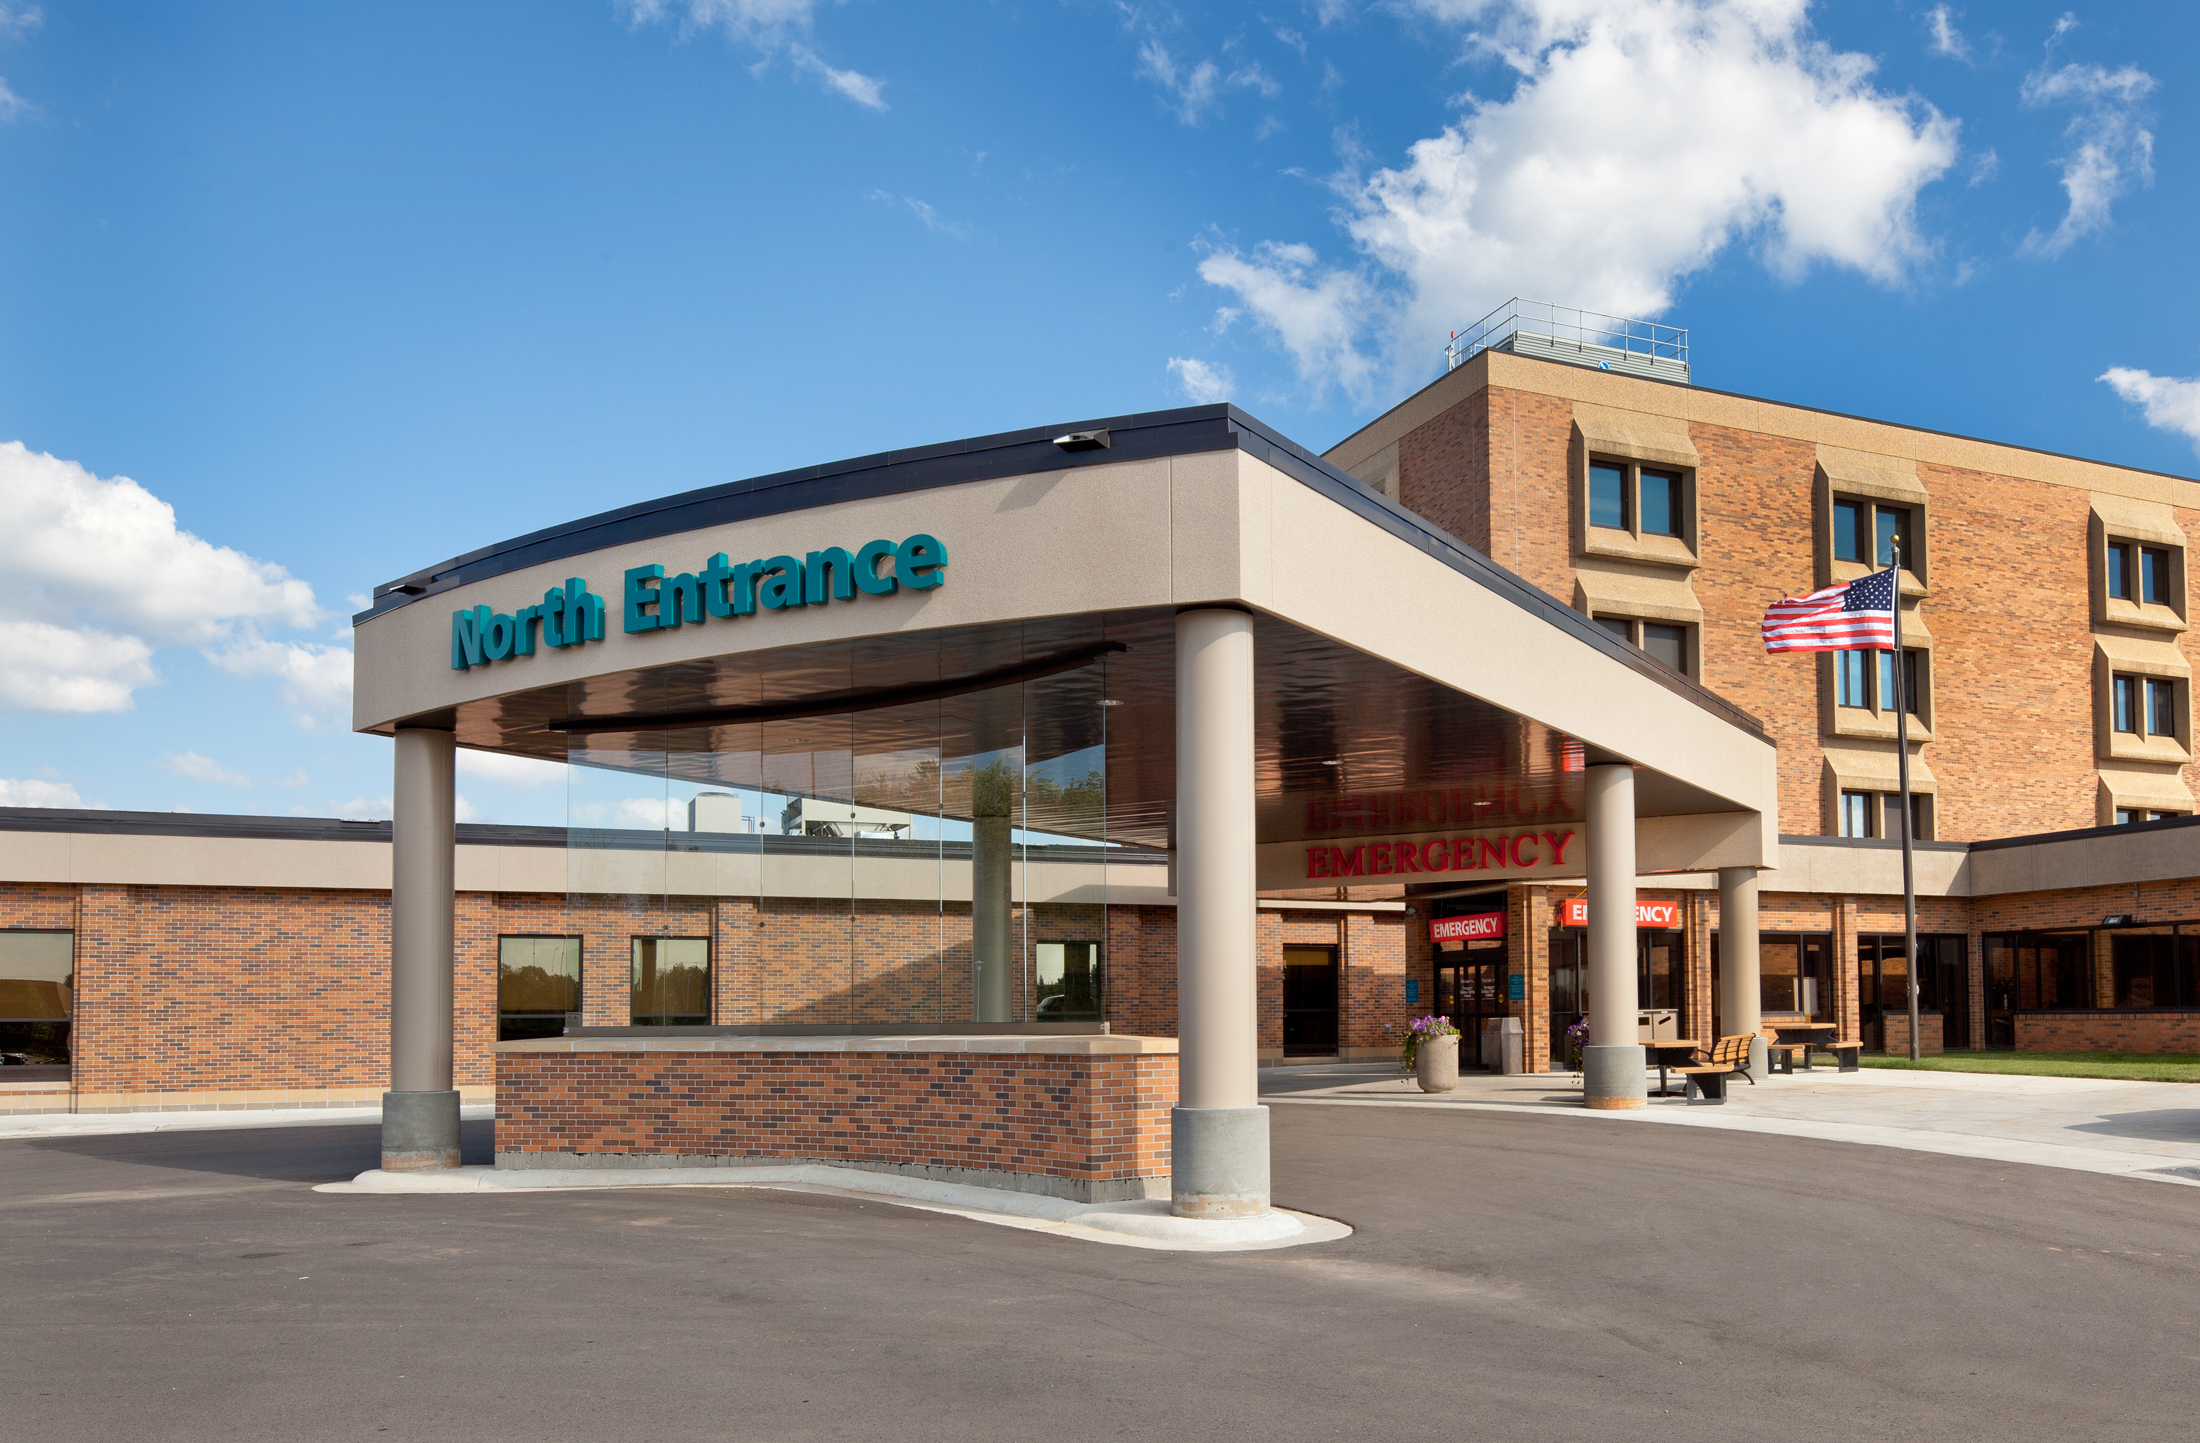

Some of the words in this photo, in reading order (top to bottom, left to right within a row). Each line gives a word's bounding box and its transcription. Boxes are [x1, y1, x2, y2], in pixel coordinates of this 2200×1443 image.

[451, 577, 606, 671] North
[624, 533, 948, 636] Entrance
[1305, 832, 1576, 879] EMERGENCY
[1433, 917, 1498, 939] EMERGENCY
